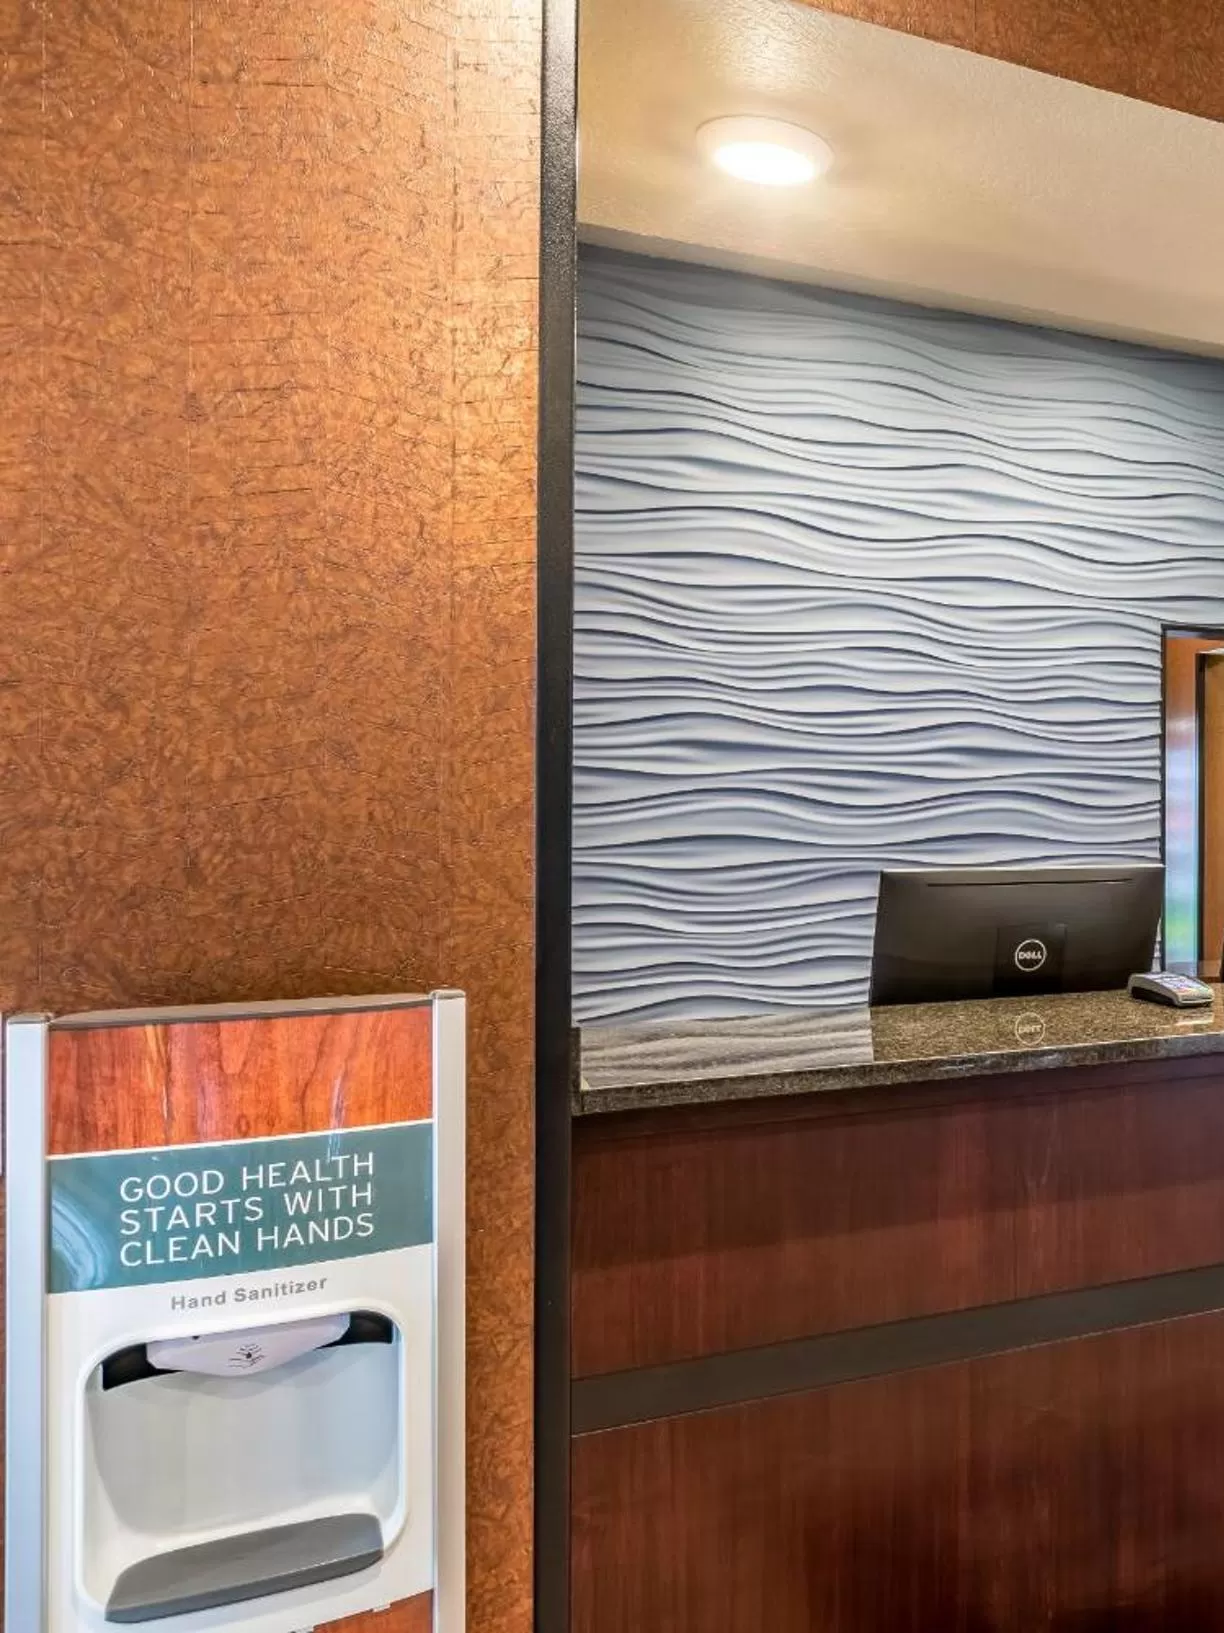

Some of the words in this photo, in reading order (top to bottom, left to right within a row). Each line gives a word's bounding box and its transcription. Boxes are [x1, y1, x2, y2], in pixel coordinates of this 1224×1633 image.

[120, 1170, 224, 1203] GOOD
[243, 1152, 375, 1191] HEALTH
[120, 1197, 263, 1236] STARTS
[285, 1183, 373, 1216] WITH
[120, 1231, 240, 1267] CLEAN
[257, 1213, 375, 1251] HANDS
[171, 1284, 227, 1310] Hand
[234, 1278, 328, 1302] Sanitizer
